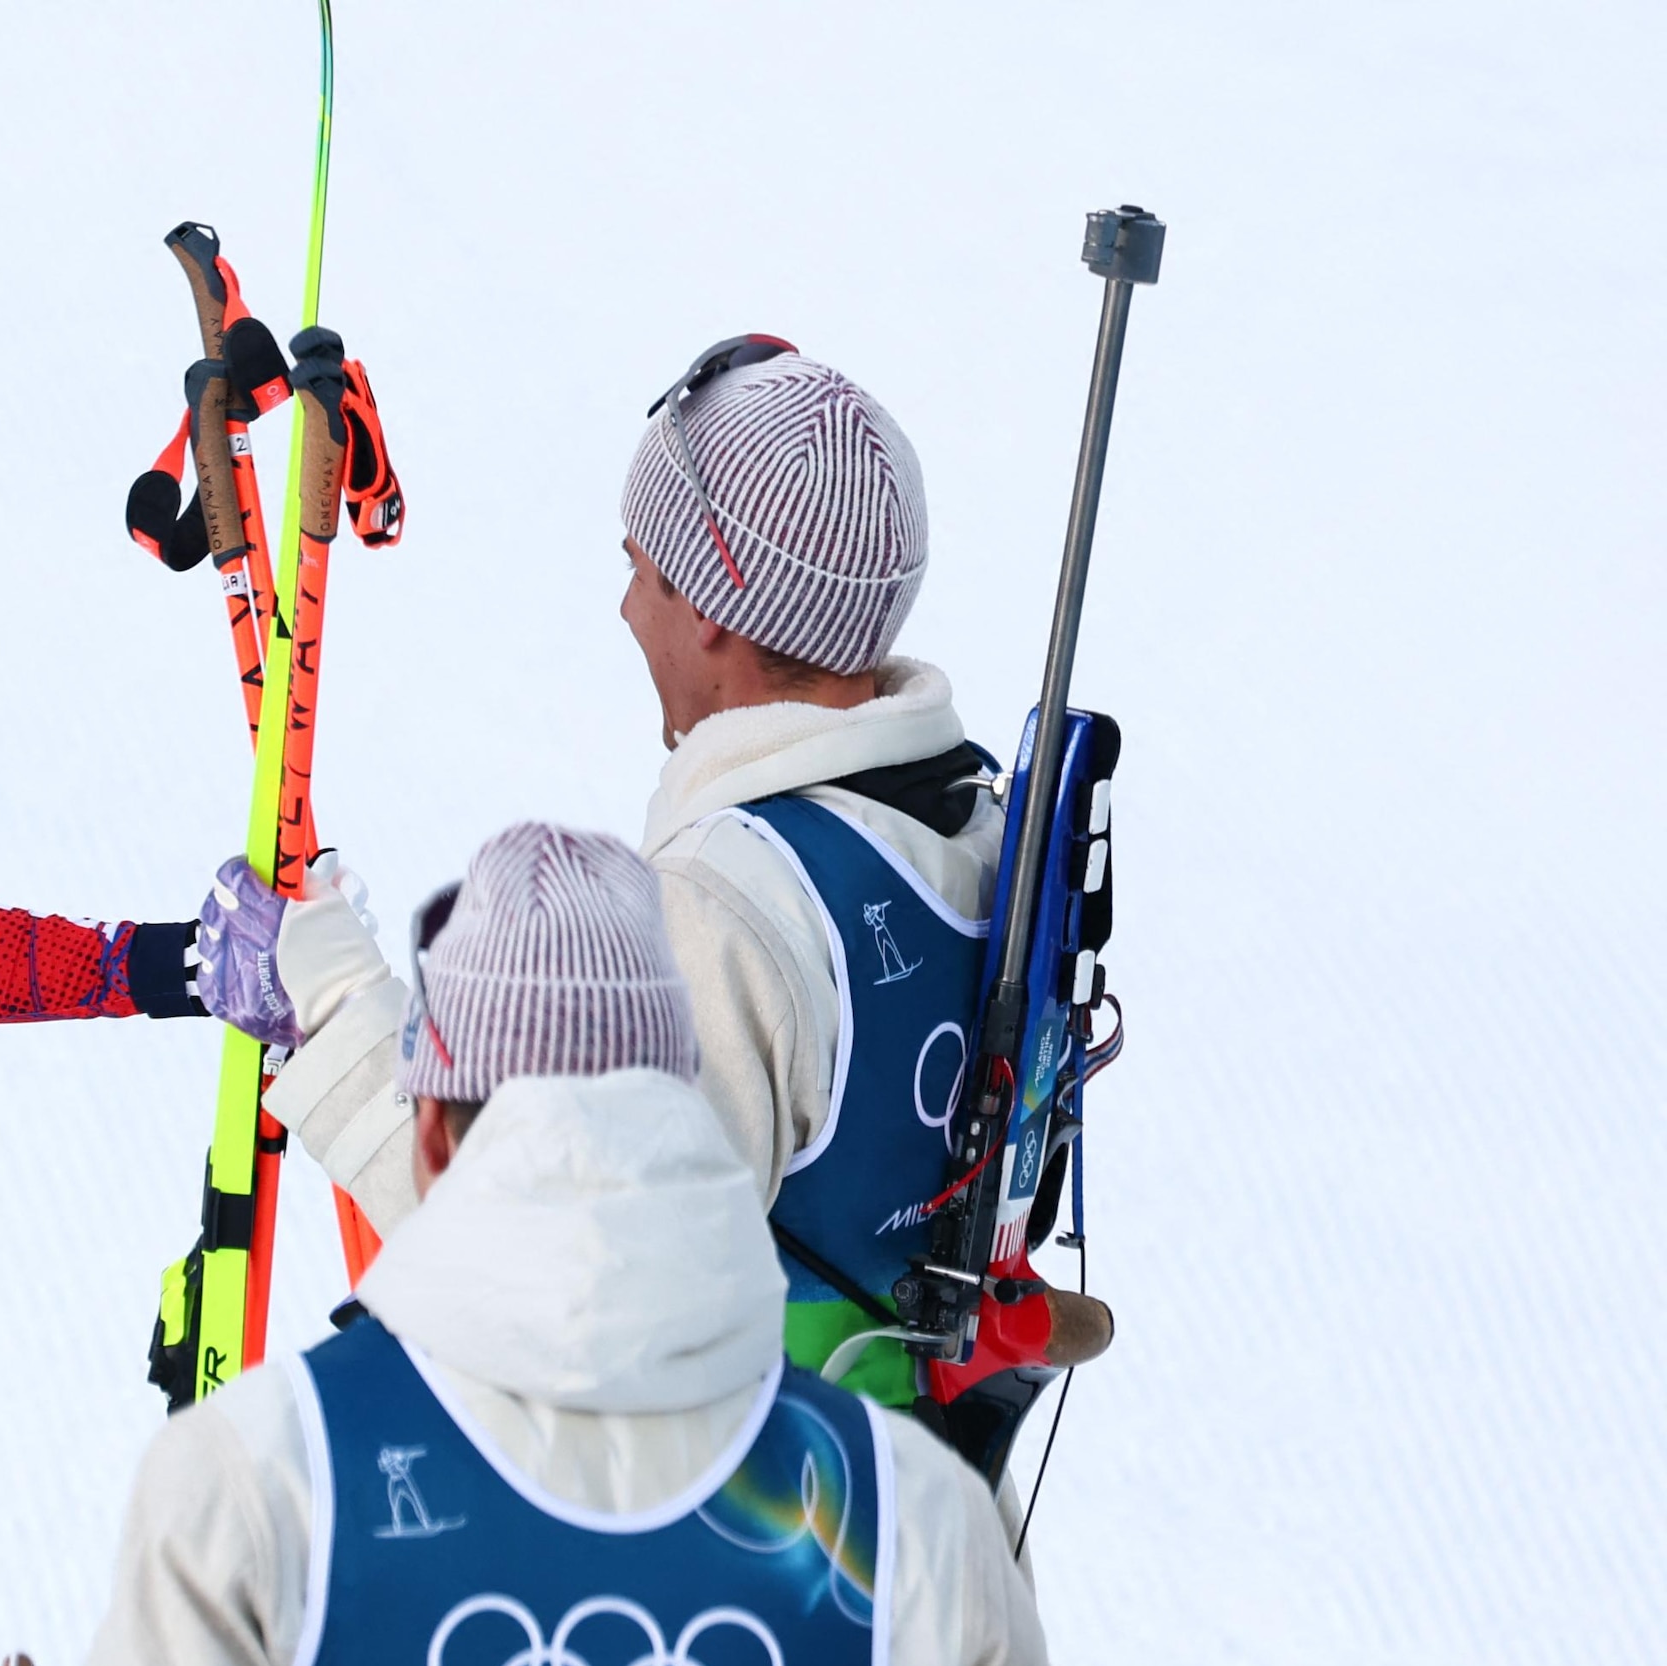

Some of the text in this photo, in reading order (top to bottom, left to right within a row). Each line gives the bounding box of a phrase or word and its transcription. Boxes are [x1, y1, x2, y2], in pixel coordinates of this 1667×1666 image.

[198, 461, 222, 549] ONE/WAY
[319, 456, 335, 531] ONE/WAY
[257, 950, 273, 993] SPORTIF
[875, 1202, 943, 1236] MIL
